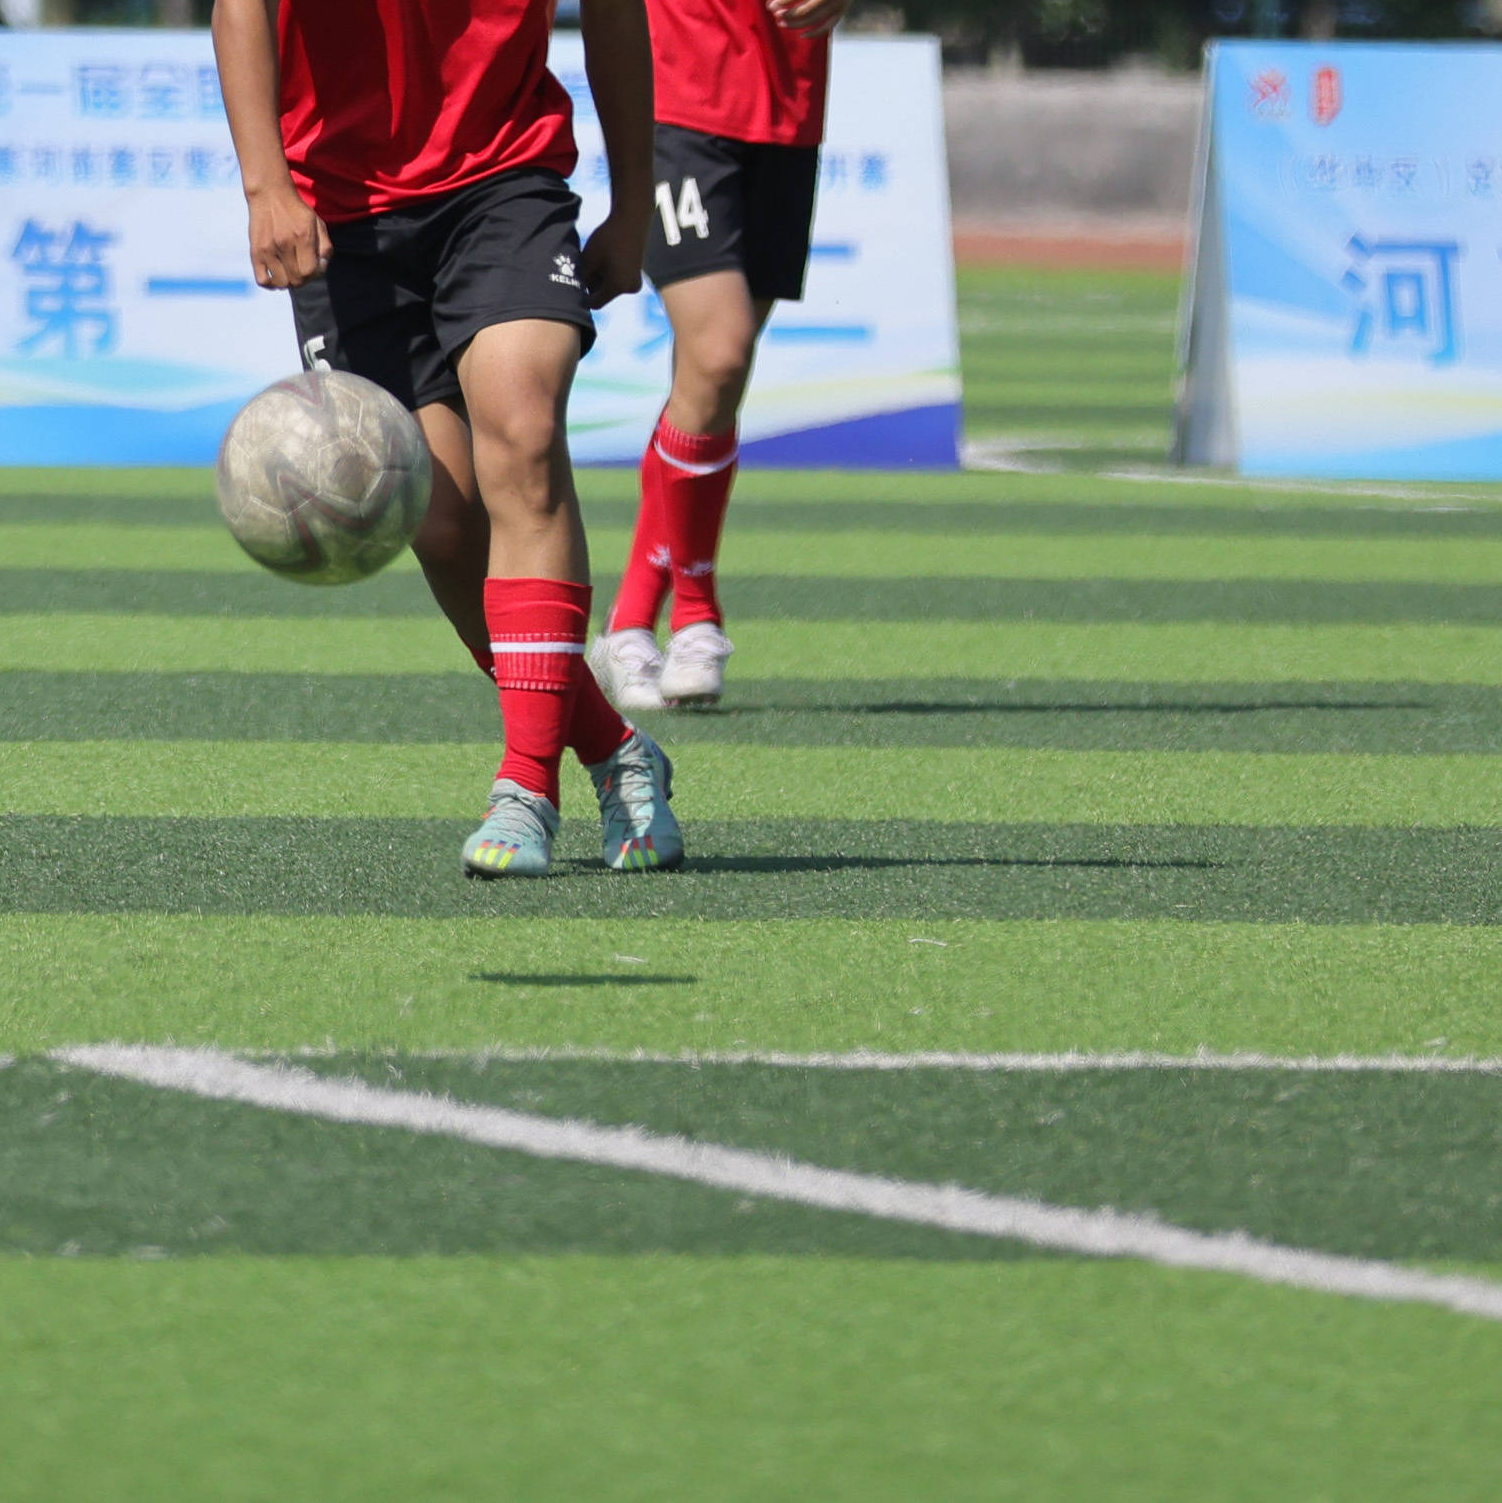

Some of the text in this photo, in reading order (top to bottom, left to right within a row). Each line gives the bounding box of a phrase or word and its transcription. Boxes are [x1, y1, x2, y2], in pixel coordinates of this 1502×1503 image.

[654, 176, 710, 246] 14
[549, 273, 582, 290] KELM
[1342, 231, 1461, 368] 河
